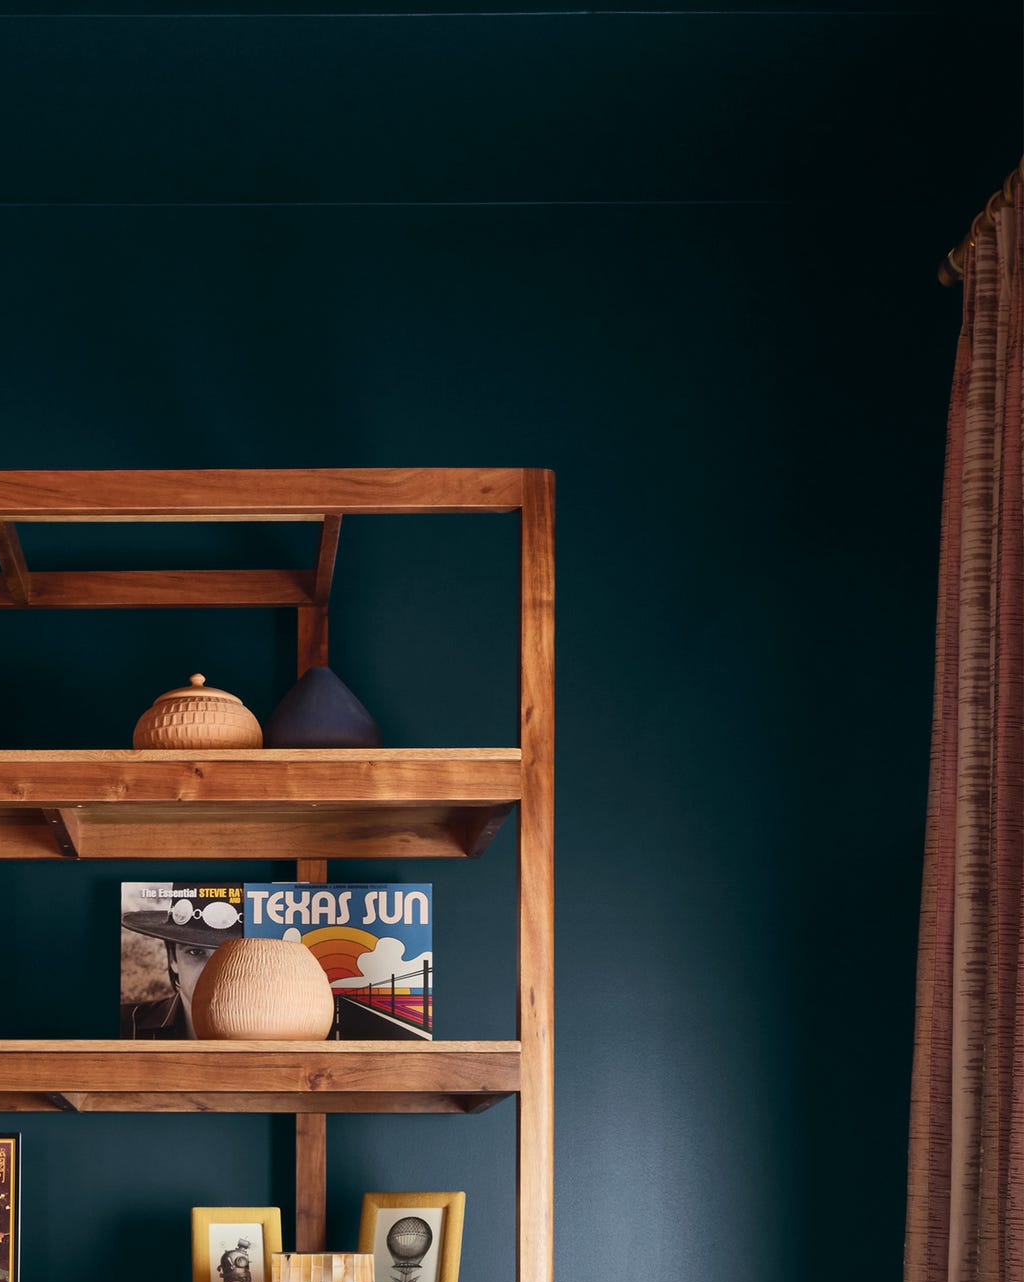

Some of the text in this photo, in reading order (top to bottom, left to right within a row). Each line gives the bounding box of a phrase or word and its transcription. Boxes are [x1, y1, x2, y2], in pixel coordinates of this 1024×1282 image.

[141, 889, 157, 898] The
[158, 888, 197, 898] Essential
[199, 888, 227, 898] STEVIE
[247, 891, 429, 925] TEXAS SUN
